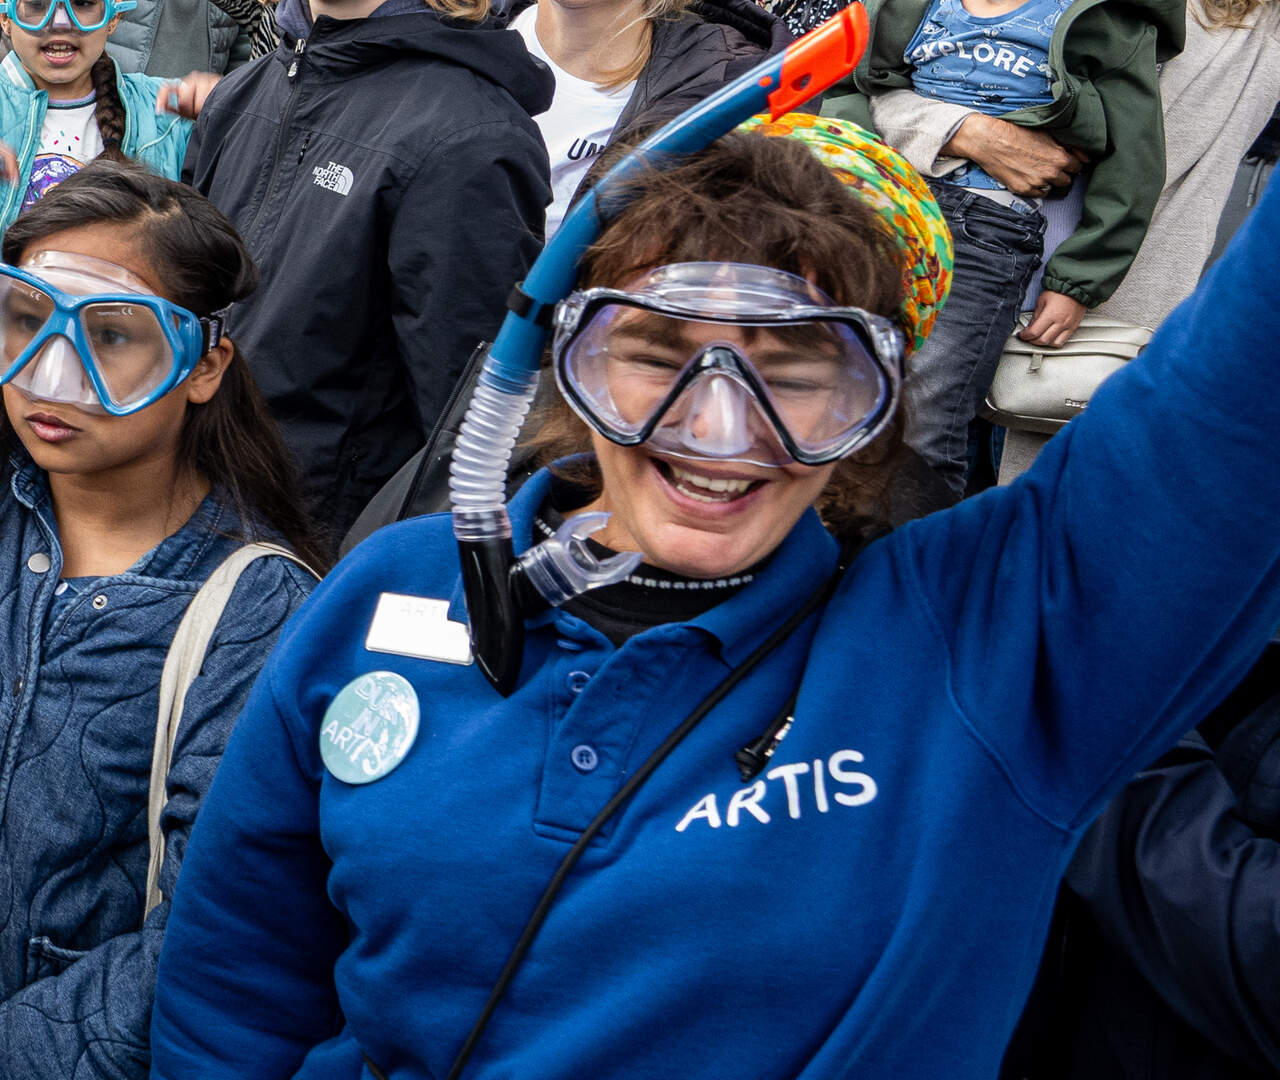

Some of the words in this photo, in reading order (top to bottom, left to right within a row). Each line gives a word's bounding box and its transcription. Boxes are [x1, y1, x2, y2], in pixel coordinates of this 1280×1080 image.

[312, 166, 340, 183] NORTH
[327, 161, 344, 174] THE
[313, 176, 336, 191] FACE
[675, 749, 878, 832] ARTIS
